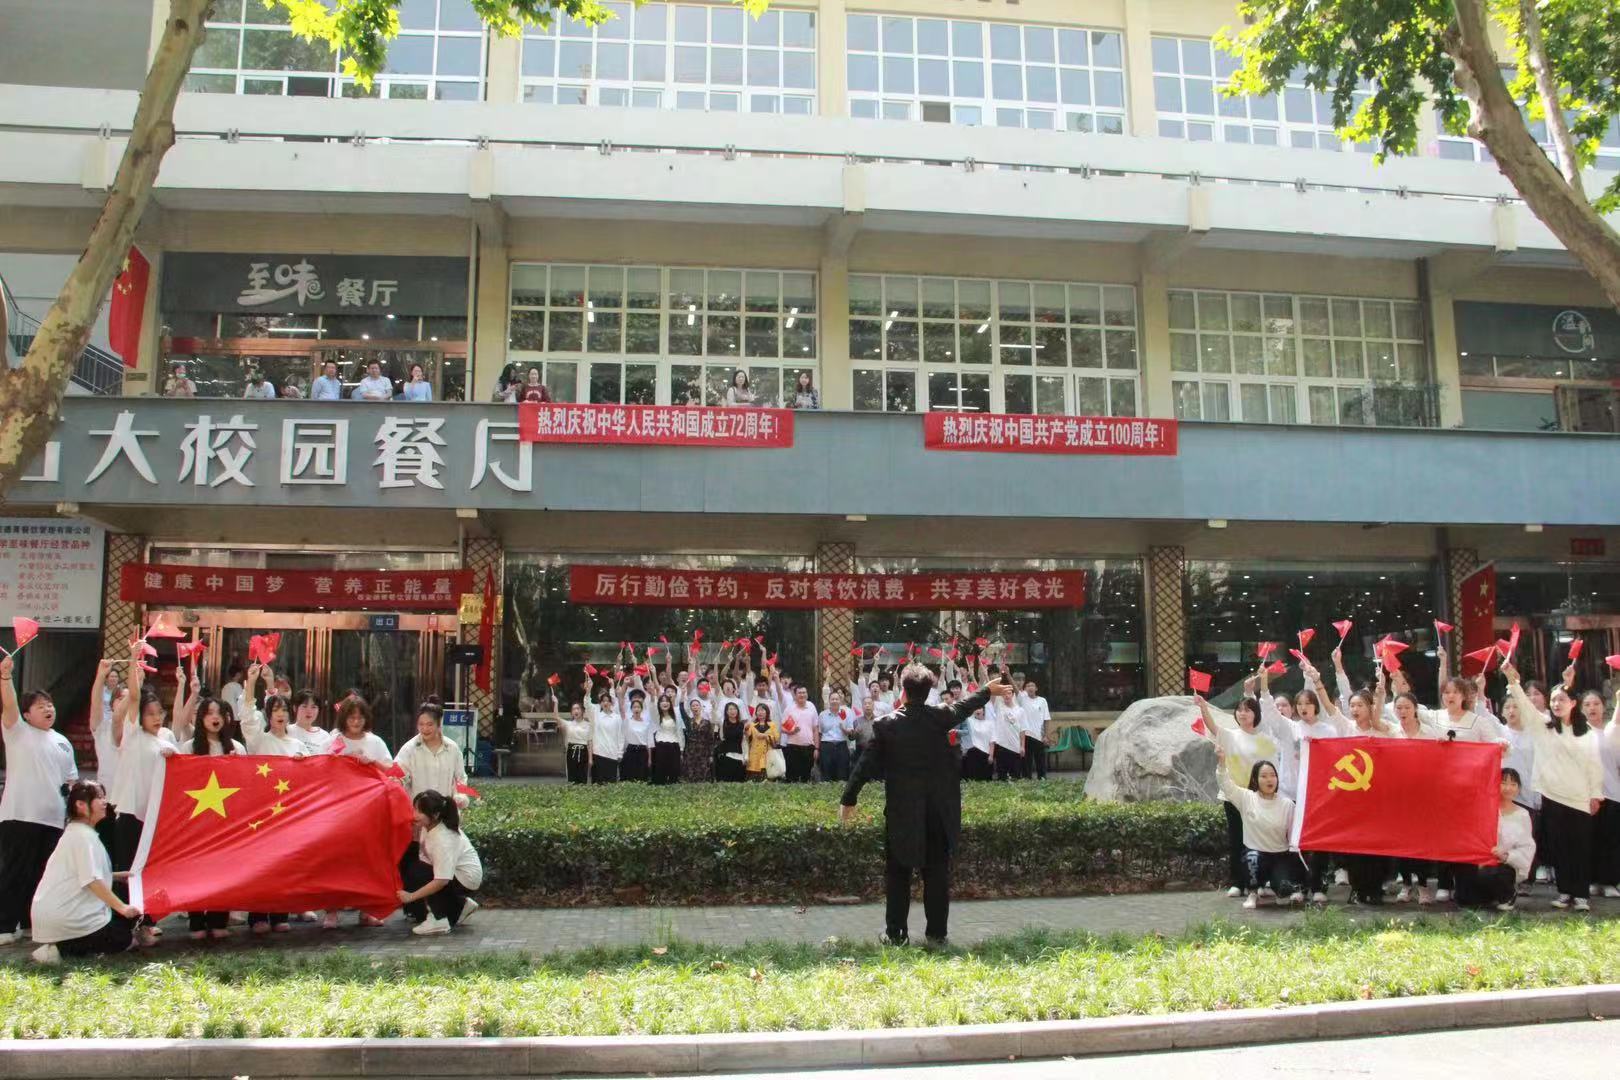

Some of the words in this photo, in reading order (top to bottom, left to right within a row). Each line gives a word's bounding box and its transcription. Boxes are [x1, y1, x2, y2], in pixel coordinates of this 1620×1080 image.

[237, 259, 325, 306] 至味
[335, 278, 398, 307] 餐厅
[143, 571, 285, 593] 健康中国梦
[314, 577, 451, 595] 营养正能量
[376, 618, 394, 626] 出口
